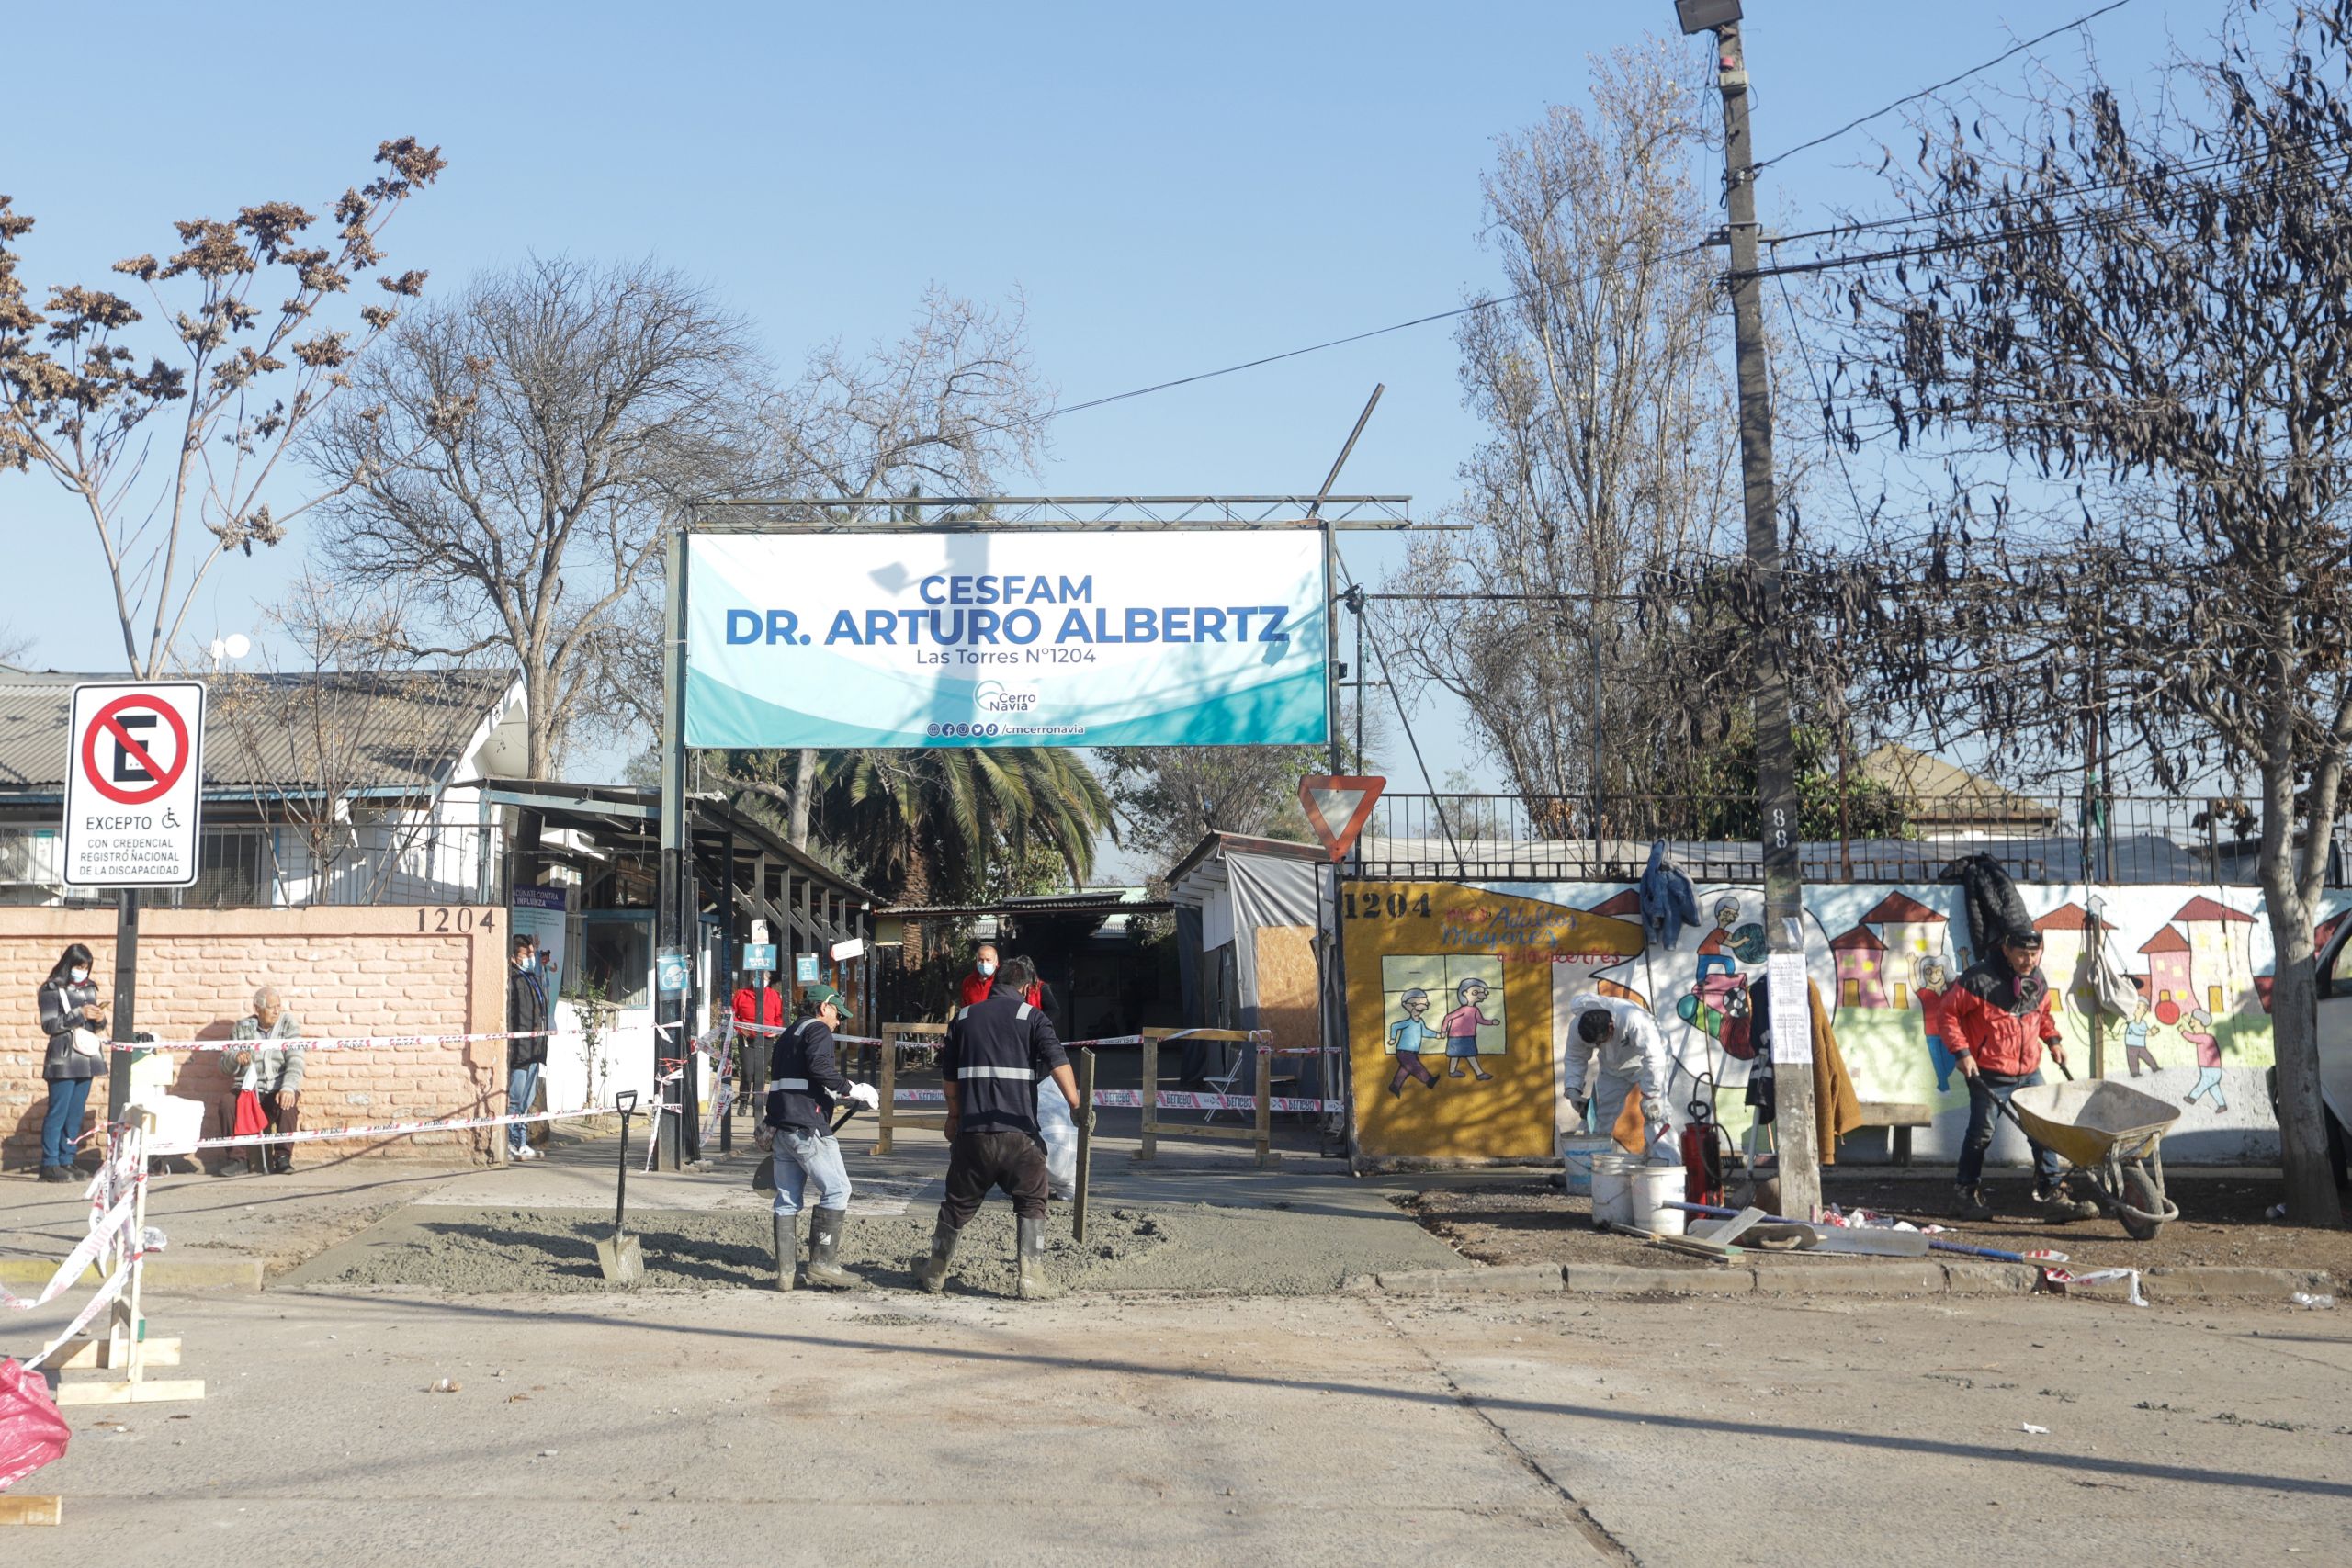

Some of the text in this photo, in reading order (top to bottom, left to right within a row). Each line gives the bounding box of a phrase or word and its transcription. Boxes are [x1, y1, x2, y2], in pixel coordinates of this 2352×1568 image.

[920, 575, 1092, 604] CESFAM
[726, 606, 1290, 646] DR. ARTURO ALBERTZ
[917, 649, 951, 664] Las
[956, 649, 1019, 664] Torres
[999, 693, 1036, 703] Cerro
[989, 701, 1028, 711] Navia
[1001, 724, 1084, 735] /cmcerronavia
[86, 816, 152, 830] EXCEPTO
[87, 838, 174, 849] CON CREDENCIAL
[80, 851, 180, 862] REGISTRO NACIONAL
[79, 865, 180, 875] DE LA DISCAPACIDAD
[536, 891, 559, 900] CONTRA
[1344, 892, 1431, 919] 1204
[416, 908, 495, 934] 1204
[1489, 905, 1577, 930] Adultos
[1441, 922, 1558, 951] Mayores
